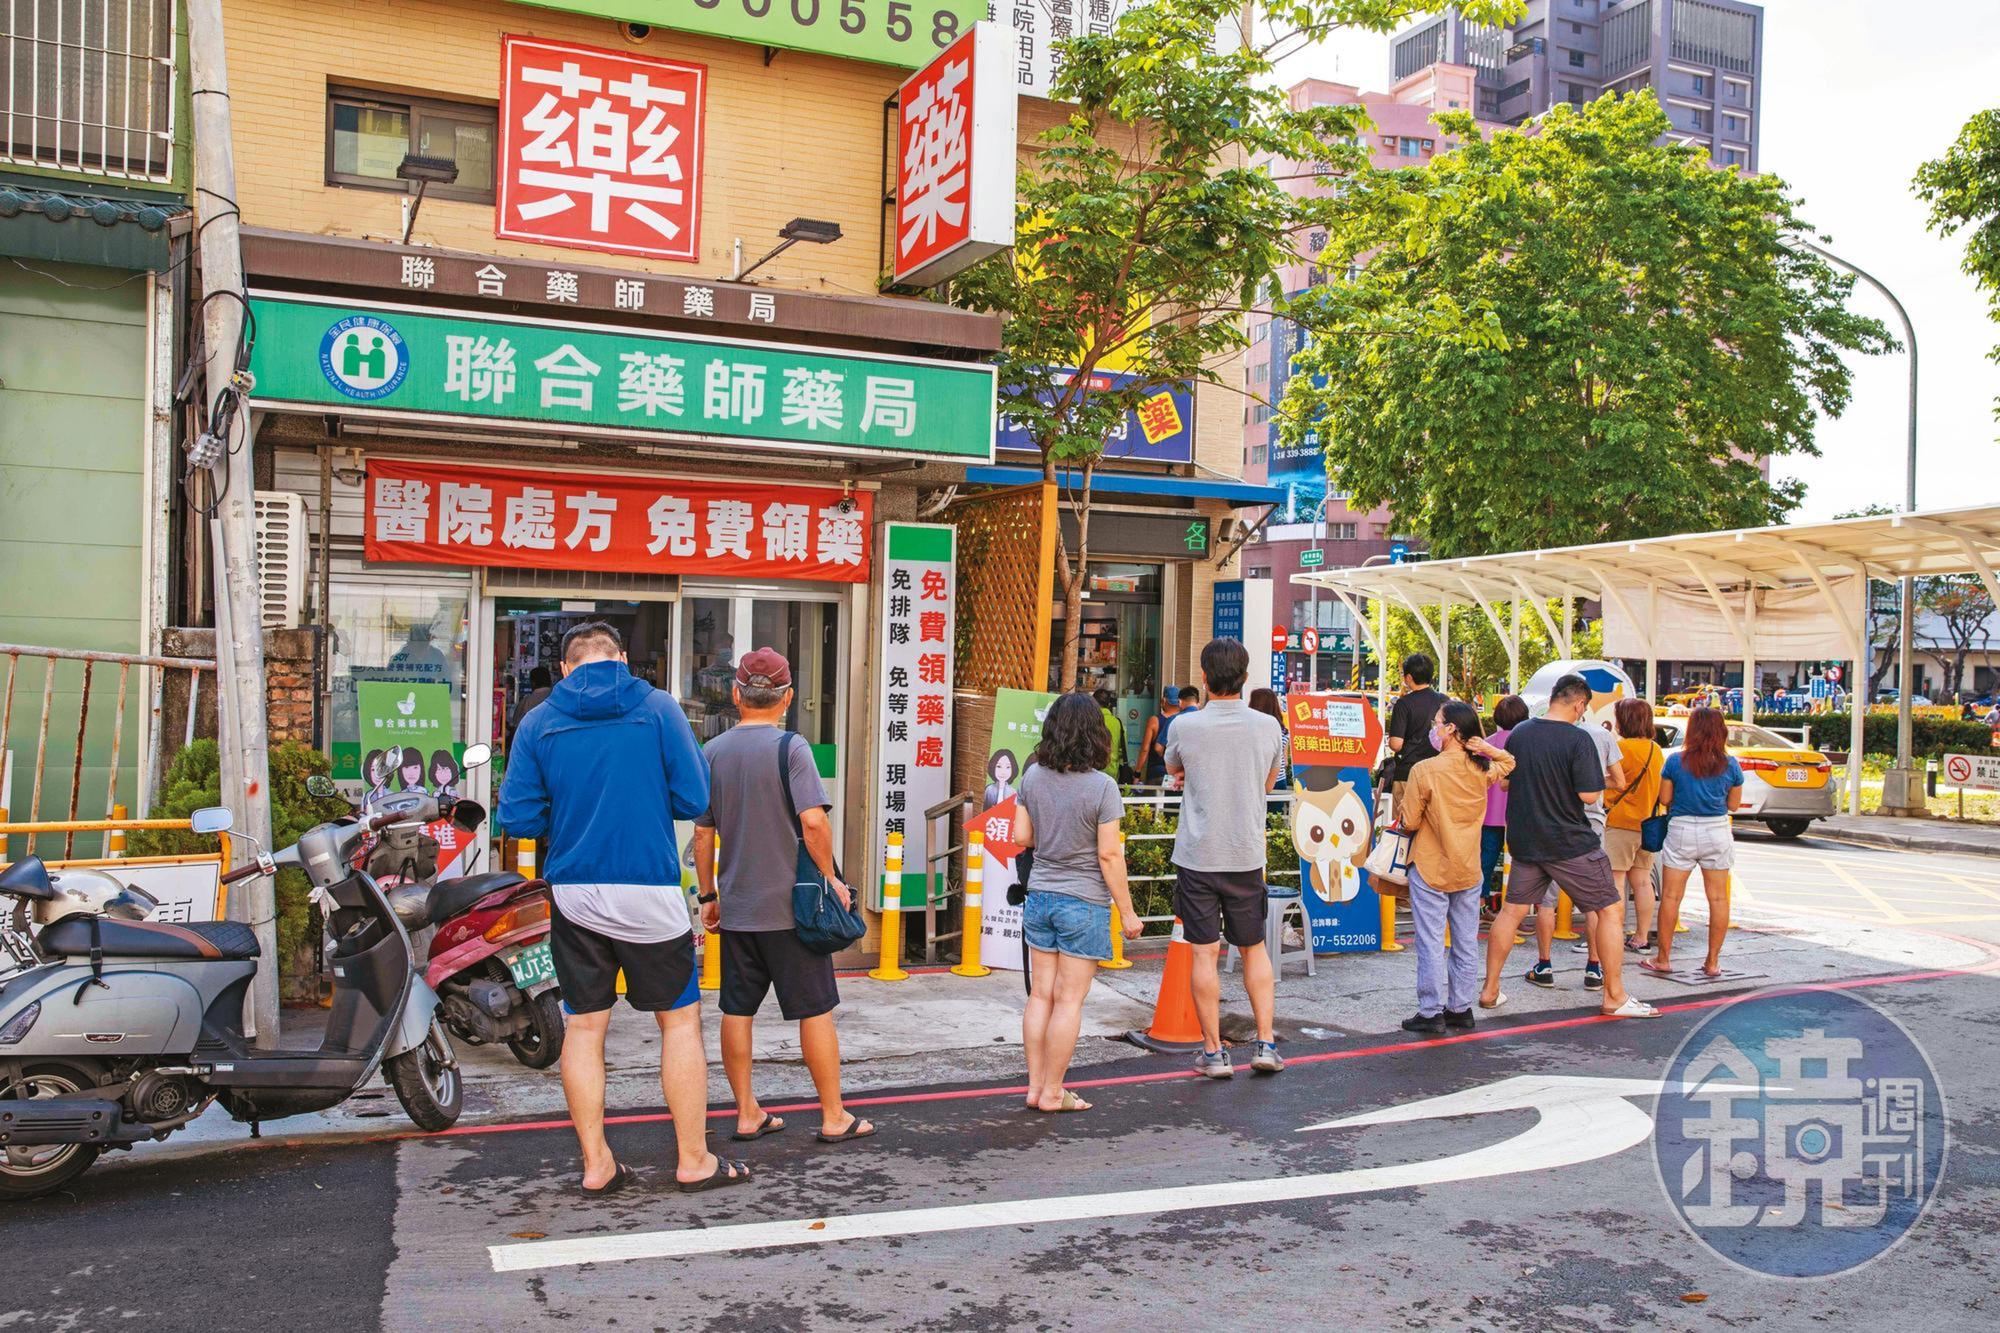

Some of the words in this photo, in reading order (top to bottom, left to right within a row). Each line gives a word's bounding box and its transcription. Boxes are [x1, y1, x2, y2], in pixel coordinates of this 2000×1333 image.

[694, 0, 959, 49] 0558
[517, 61, 686, 241] 藥
[901, 57, 969, 259] 藥
[401, 256, 776, 323] 聯合藥師藥局
[321, 352, 342, 390] NATIONAL
[345, 387, 376, 398] HEALTH
[378, 361, 407, 396] INSURANCE
[443, 335, 918, 437] 聯合藥師藥局
[373, 477, 618, 551] 醫院處方
[646, 494, 865, 566] 免費領藥
[889, 568, 912, 645] 免排隊
[887, 666, 909, 742] 免等候
[915, 569, 948, 768] 免費領藥處
[1293, 735, 1367, 754] 領藥由此進入
[884, 764, 906, 866] 現場領
[985, 816, 1016, 843] 領
[980, 926, 1021, 939] 業·親切
[1312, 934, 1377, 947] 07-5522006
